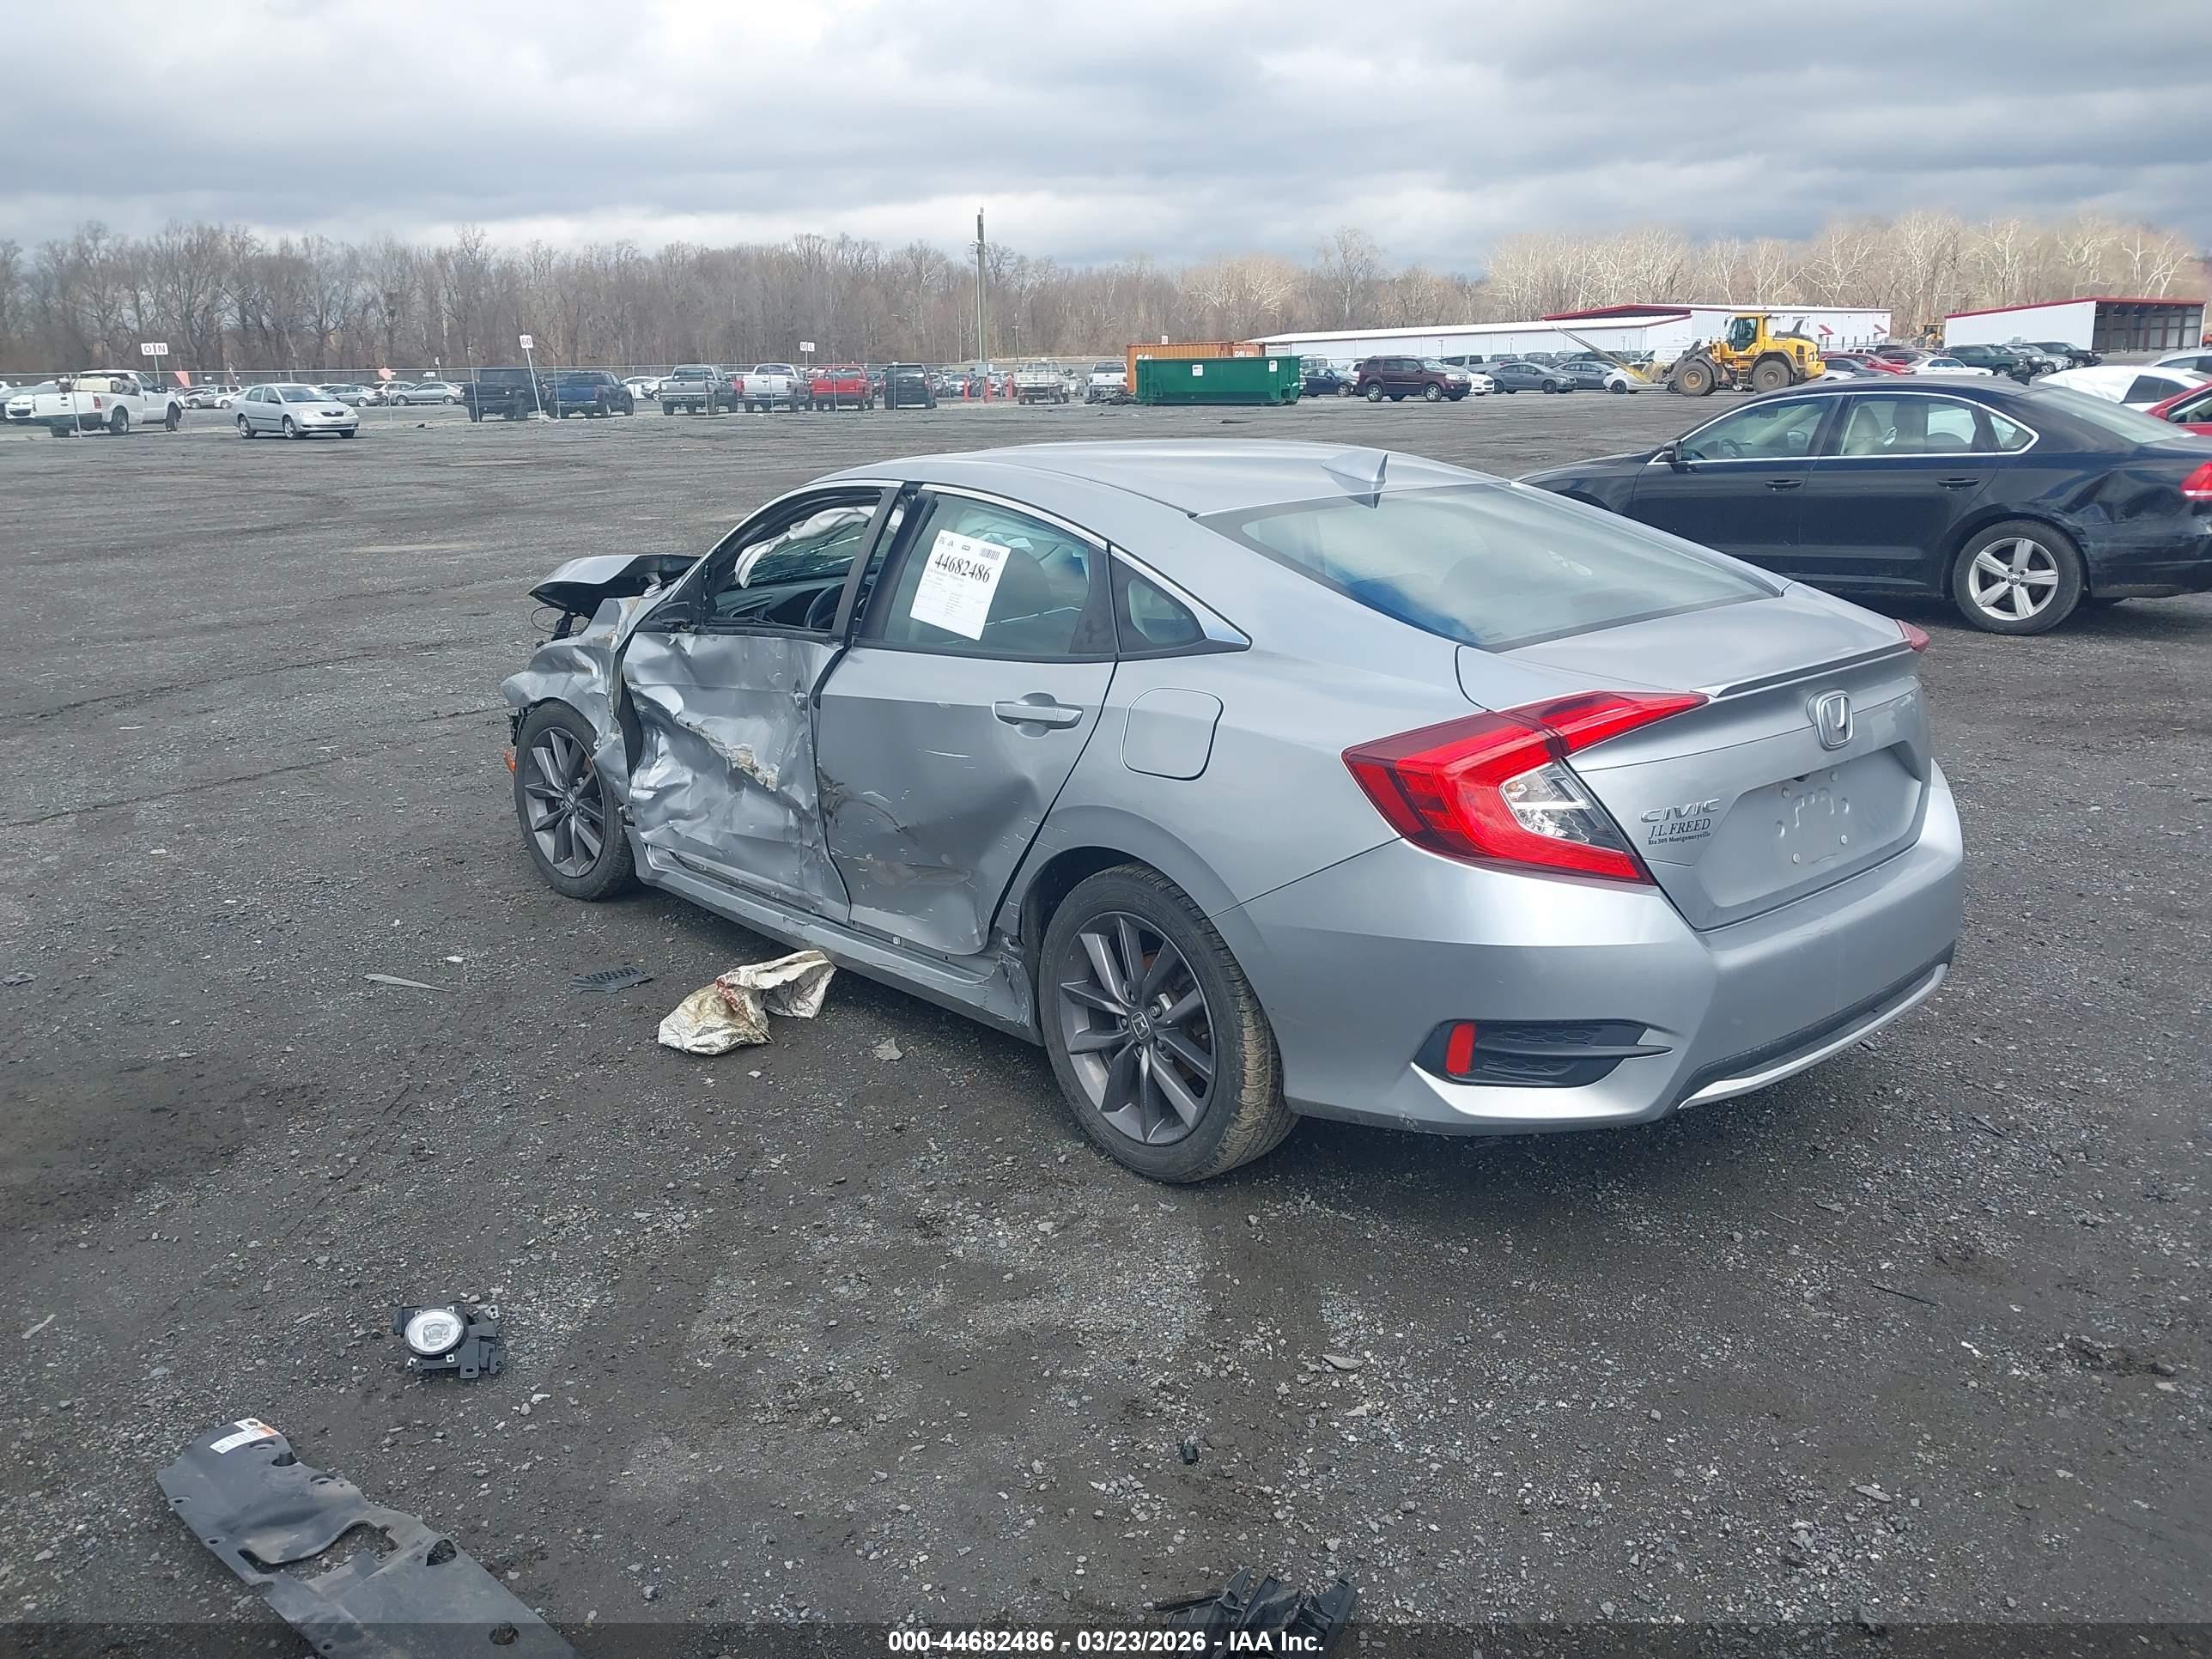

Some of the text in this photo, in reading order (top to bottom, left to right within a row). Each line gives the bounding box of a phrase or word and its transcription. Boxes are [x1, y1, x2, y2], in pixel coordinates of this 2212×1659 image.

[935, 553, 994, 583] 44682486
[1641, 799, 1720, 823] CIVIC
[1649, 818, 1711, 839] J.L. FREED
